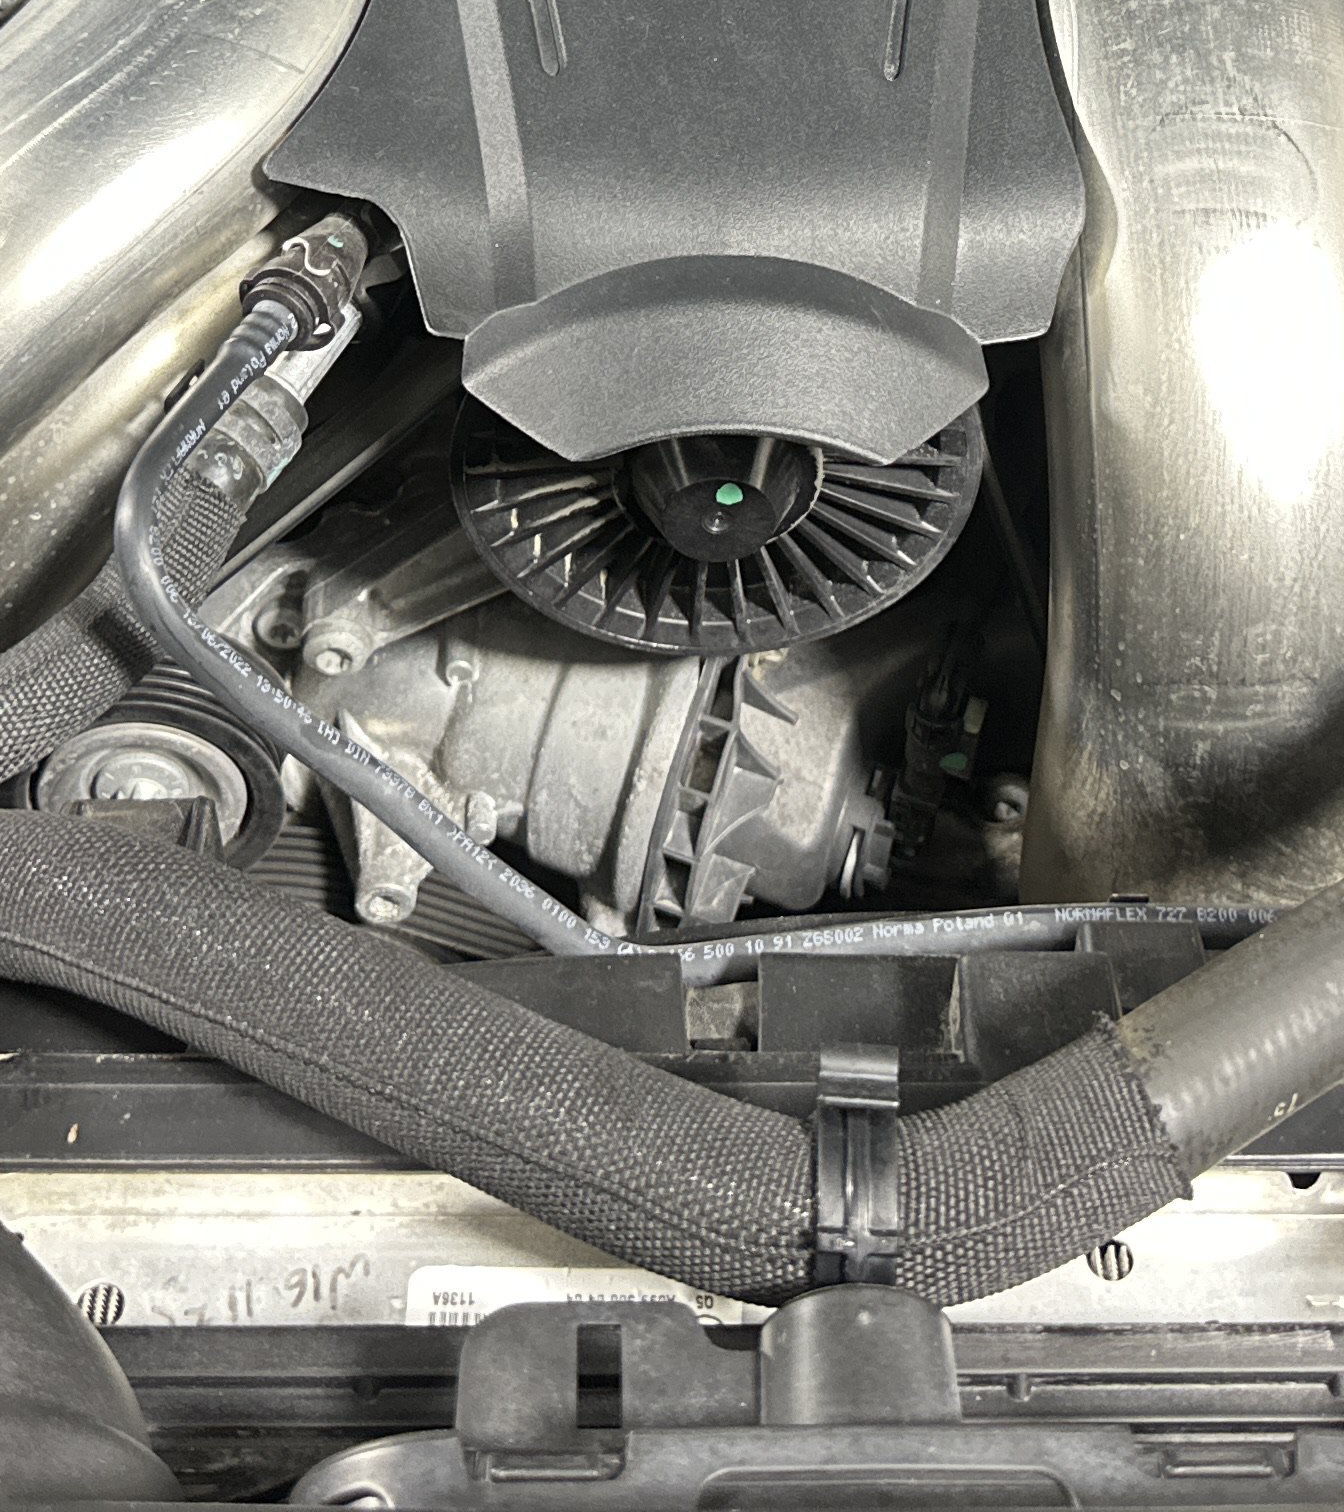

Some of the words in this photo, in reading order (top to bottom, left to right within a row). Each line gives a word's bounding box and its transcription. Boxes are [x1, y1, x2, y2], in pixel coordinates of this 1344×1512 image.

[499, 867, 535, 899] 2036
[541, 897, 577, 929] 0100
[703, 944, 735, 960] 500
[745, 939, 765, 955] 10
[772, 938, 793, 952] 91
[872, 922, 926, 939] Norma
[932, 912, 995, 933] Poland
[1055, 906, 1149, 922] NORMAFLEX
[1156, 905, 1188, 922] 727
[431, 1291, 475, 1306] 1136A
